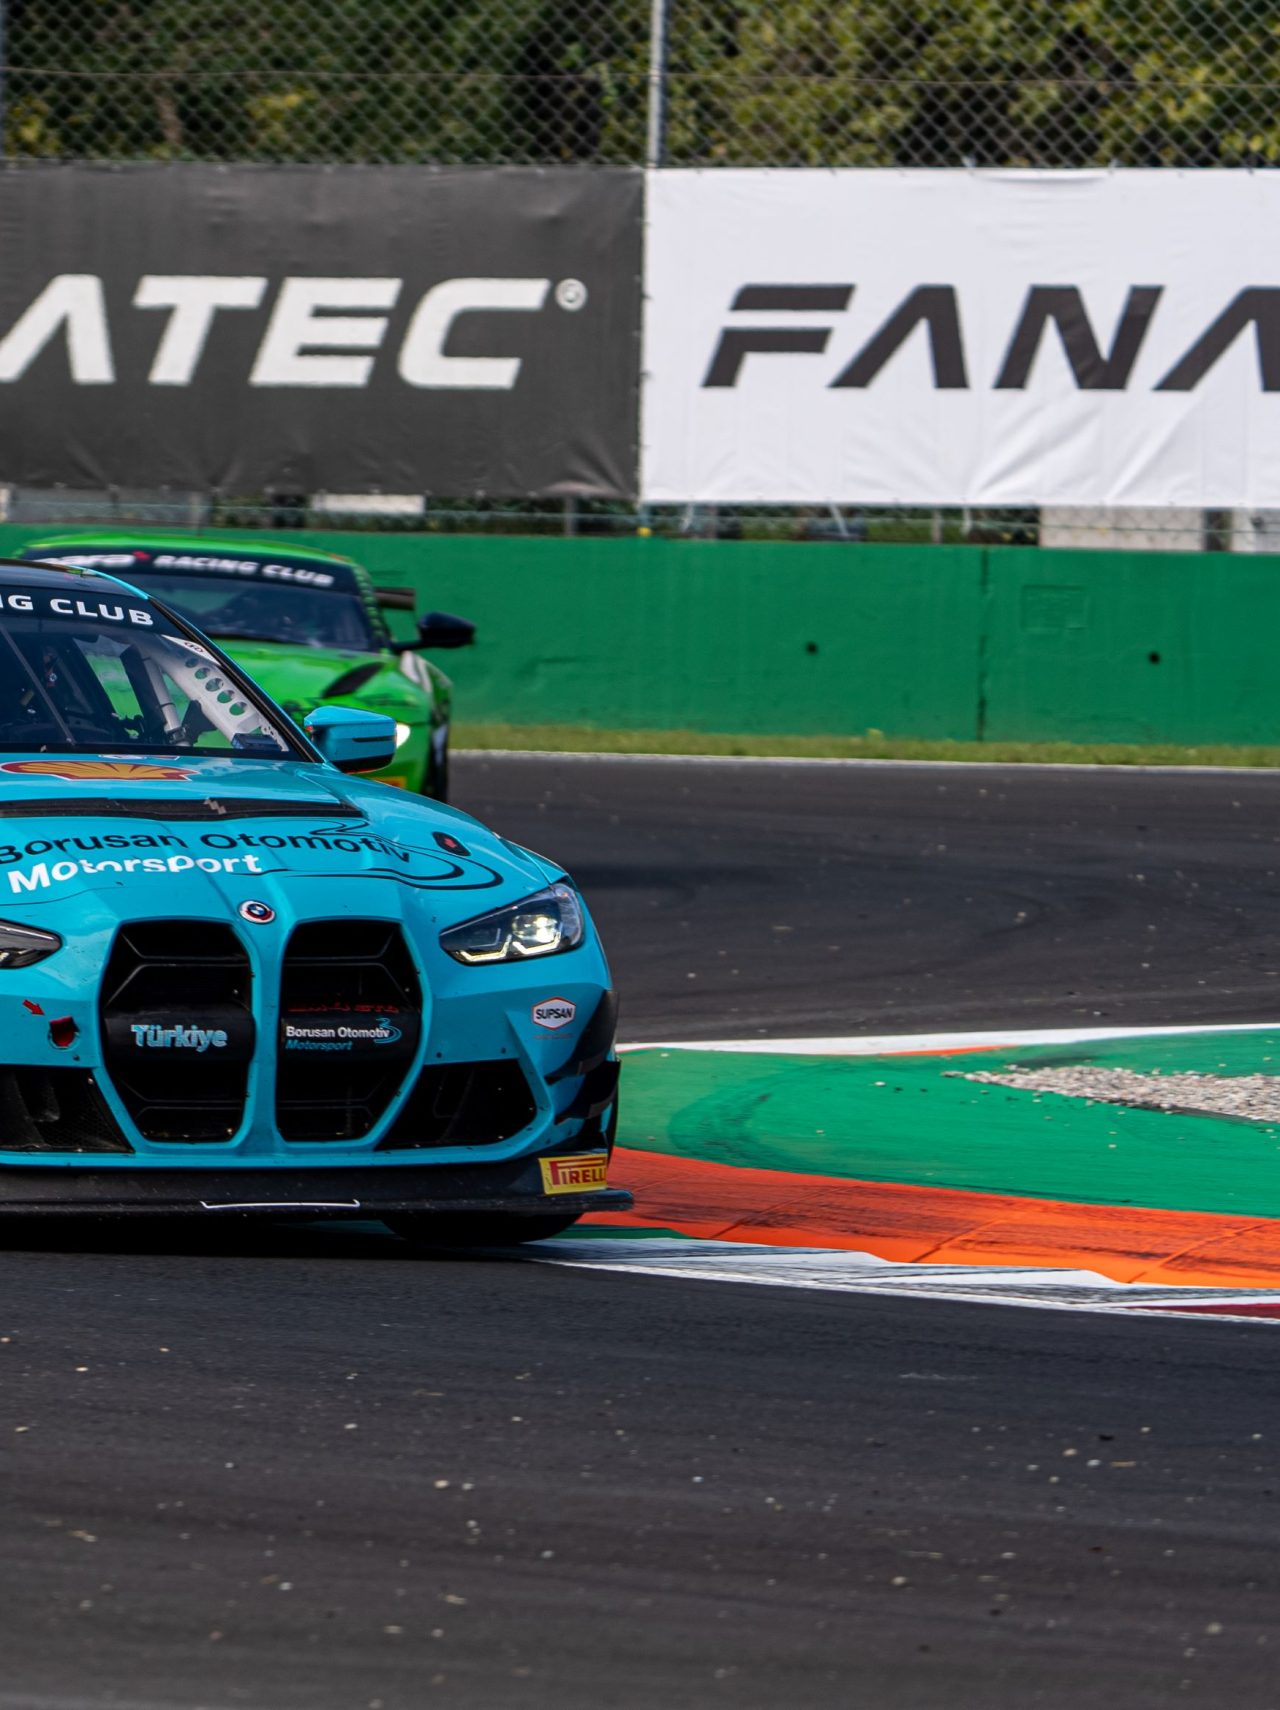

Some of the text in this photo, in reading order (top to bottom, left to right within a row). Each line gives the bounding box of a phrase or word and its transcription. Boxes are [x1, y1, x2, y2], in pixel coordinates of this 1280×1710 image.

[153, 554, 258, 575] RACING
[49, 598, 155, 626] CLUB
[200, 831, 411, 864] Otomotiv
[6, 853, 263, 894] Motorsport
[536, 1007, 573, 1020] SUPSAN
[131, 1024, 228, 1052] Türkiye
[285, 1025, 391, 1039] Borusan Otomotiv
[285, 1039, 353, 1051] Motorsport
